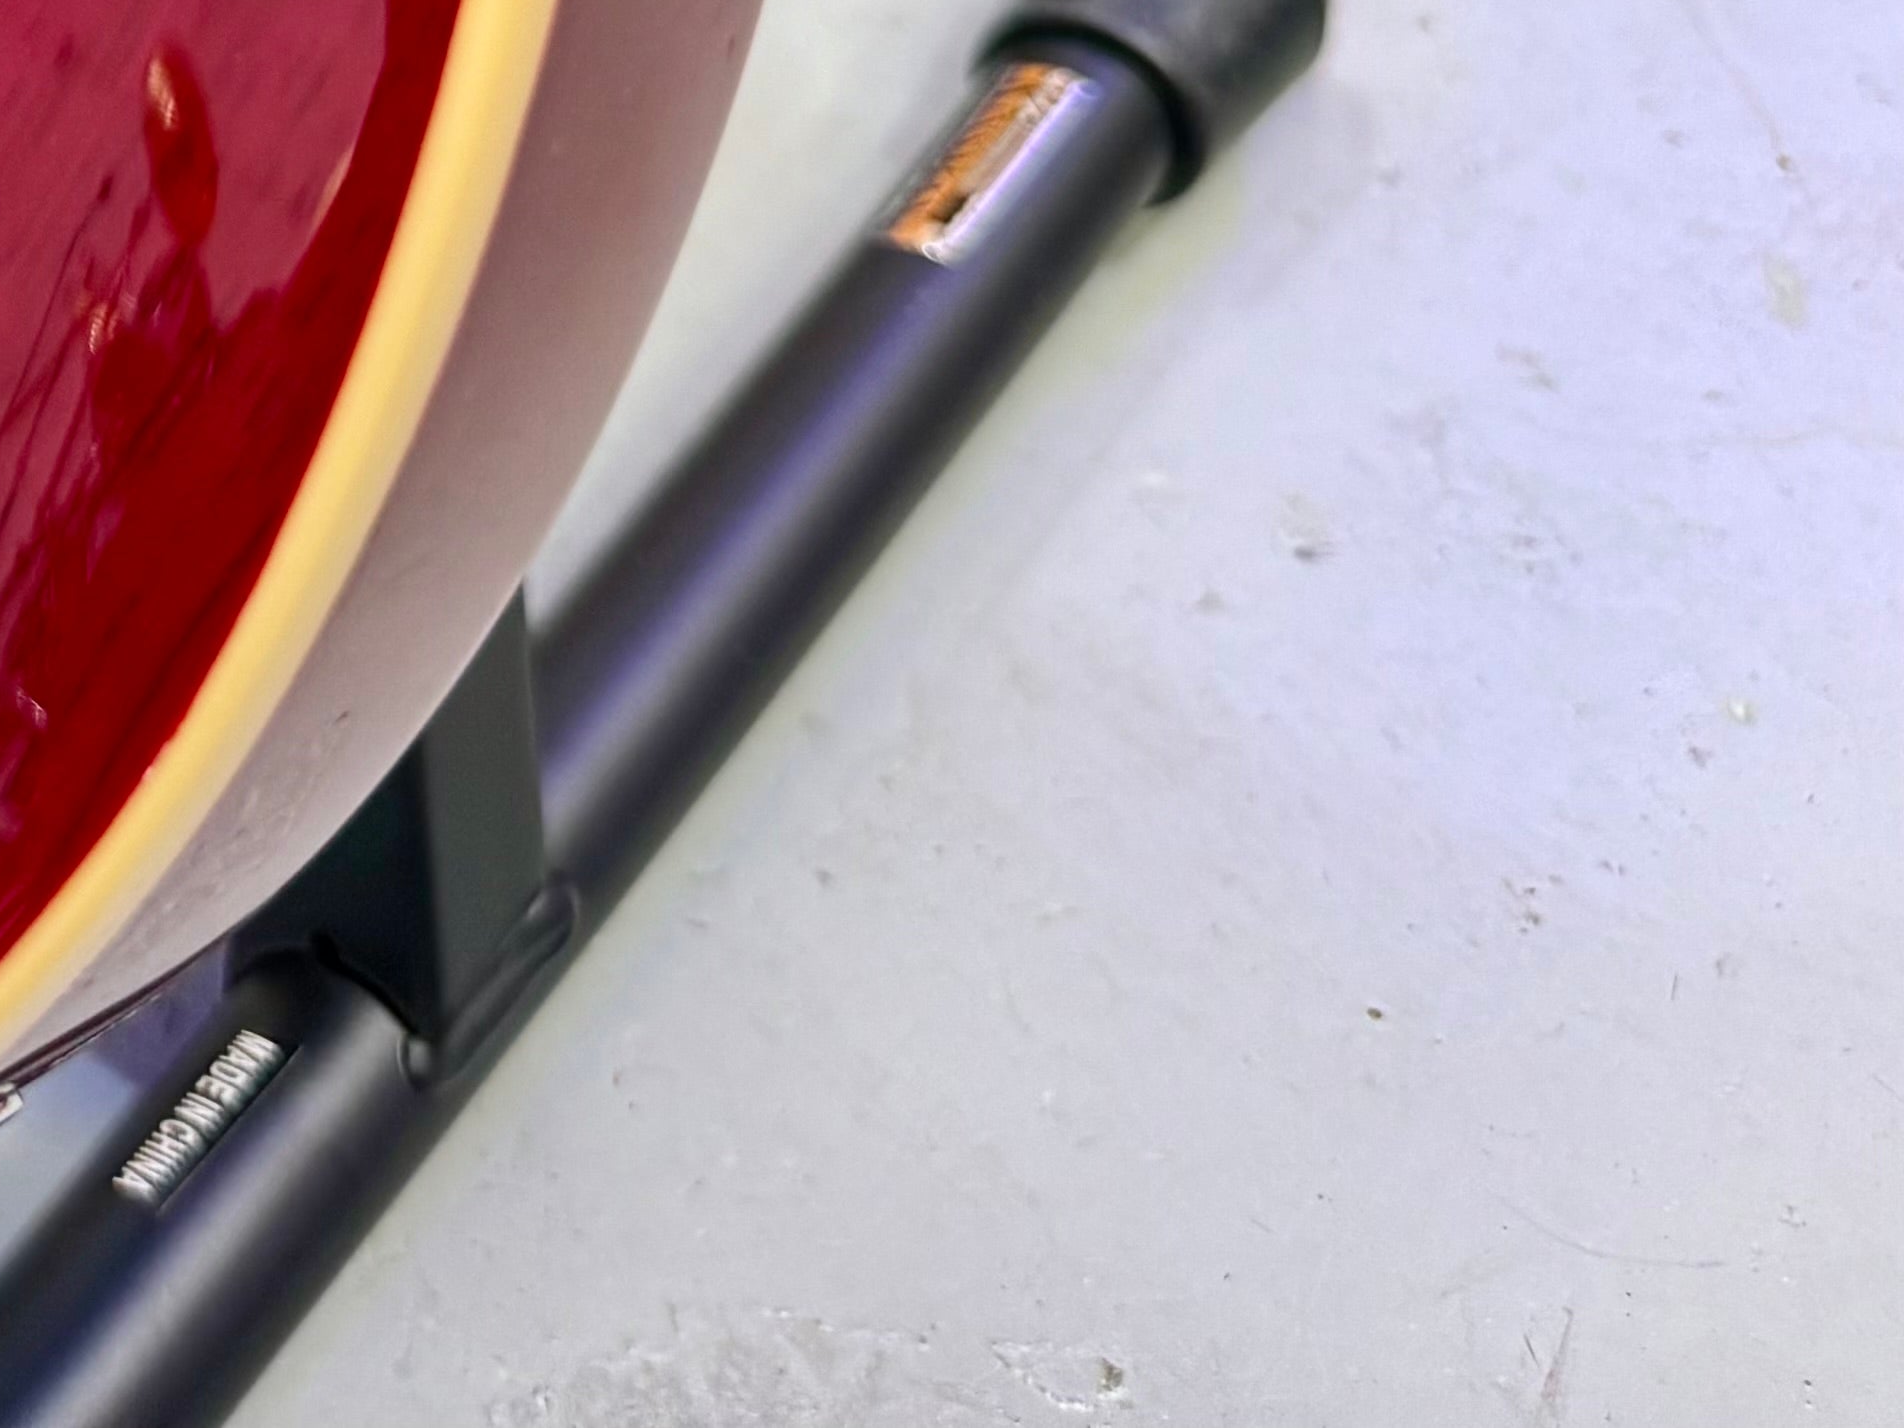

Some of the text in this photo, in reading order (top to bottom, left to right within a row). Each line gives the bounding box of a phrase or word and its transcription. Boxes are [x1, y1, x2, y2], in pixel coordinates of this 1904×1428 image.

[111, 1029, 284, 1202] MADE IN CHINA
